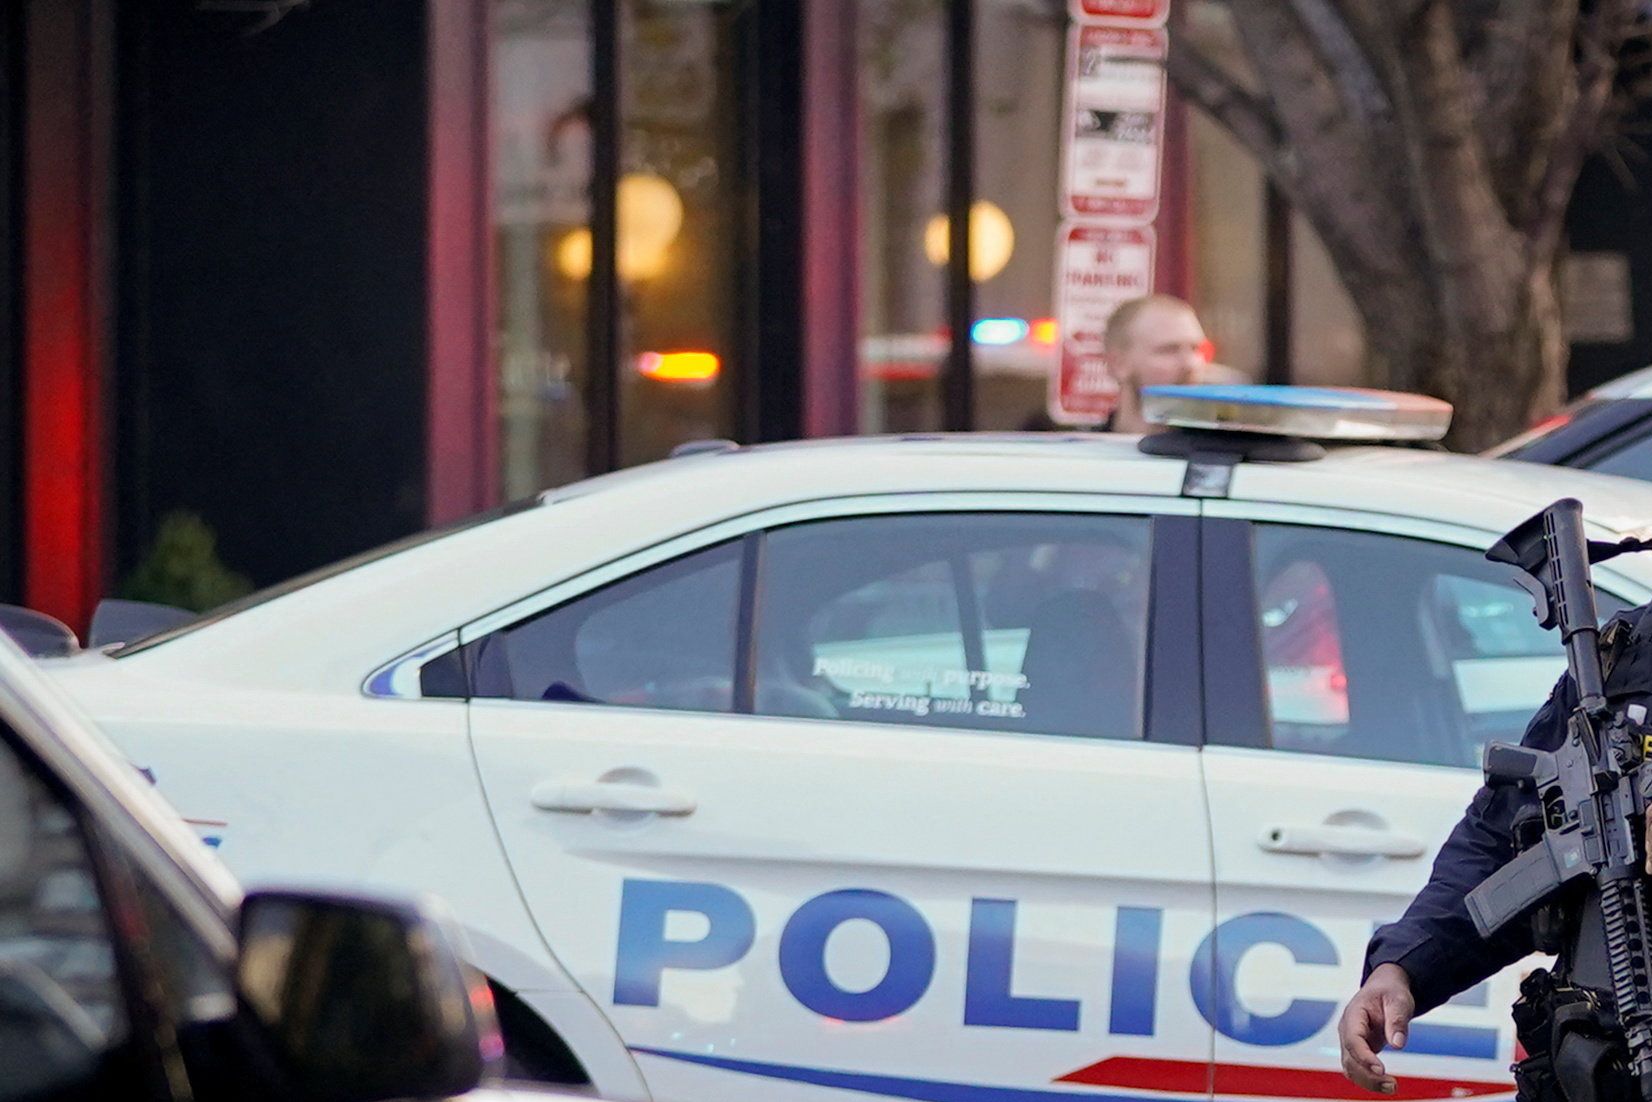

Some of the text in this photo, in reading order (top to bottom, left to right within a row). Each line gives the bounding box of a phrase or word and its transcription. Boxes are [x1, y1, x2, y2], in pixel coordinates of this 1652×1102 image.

[812, 656, 896, 683] Policing
[943, 670, 1031, 690] purpose.
[849, 690, 1027, 718] Serving with care.
